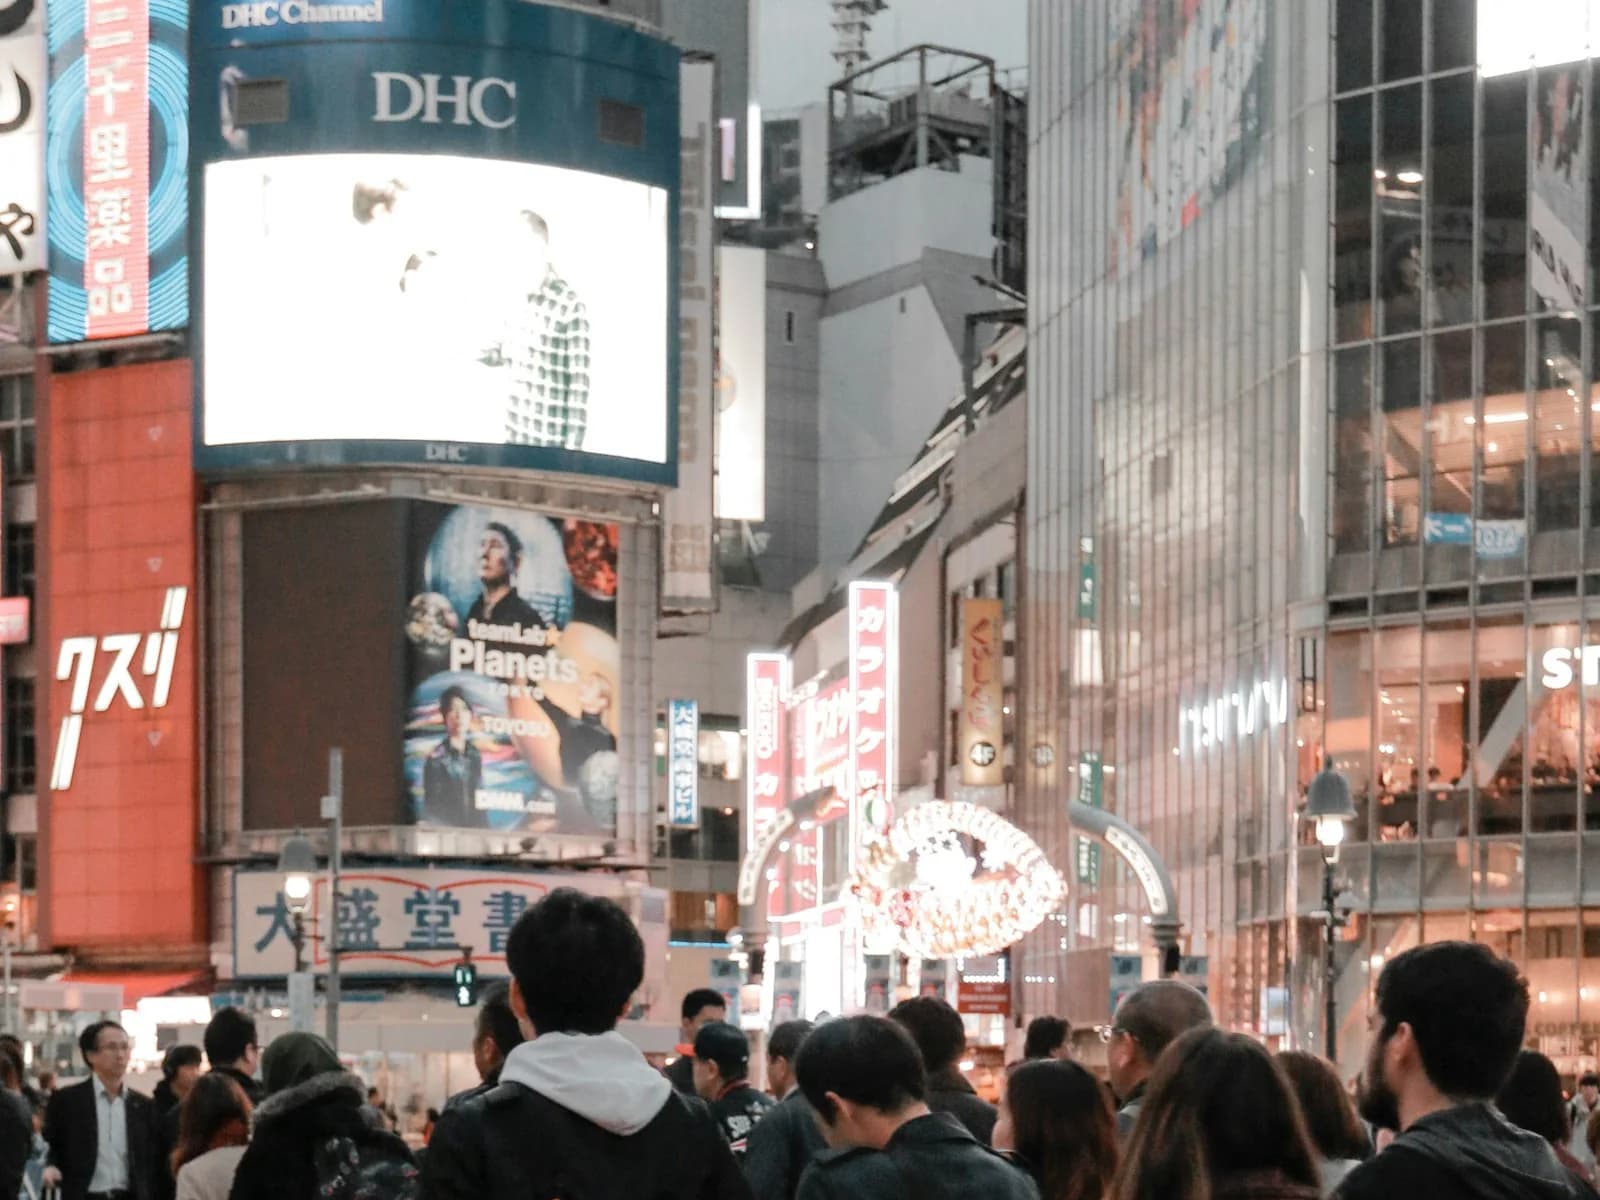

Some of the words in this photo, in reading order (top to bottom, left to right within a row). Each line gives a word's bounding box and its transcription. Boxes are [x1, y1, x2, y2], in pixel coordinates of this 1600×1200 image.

[222, 2, 279, 29] DHC
[280, 0, 384, 24] Channel
[372, 71, 518, 129] DHC
[425, 443, 469, 462] DHC
[467, 618, 547, 646] teamLab
[451, 638, 579, 684] Planets
[1542, 645, 1600, 690] ST
[50, 585, 188, 791] クスリ
